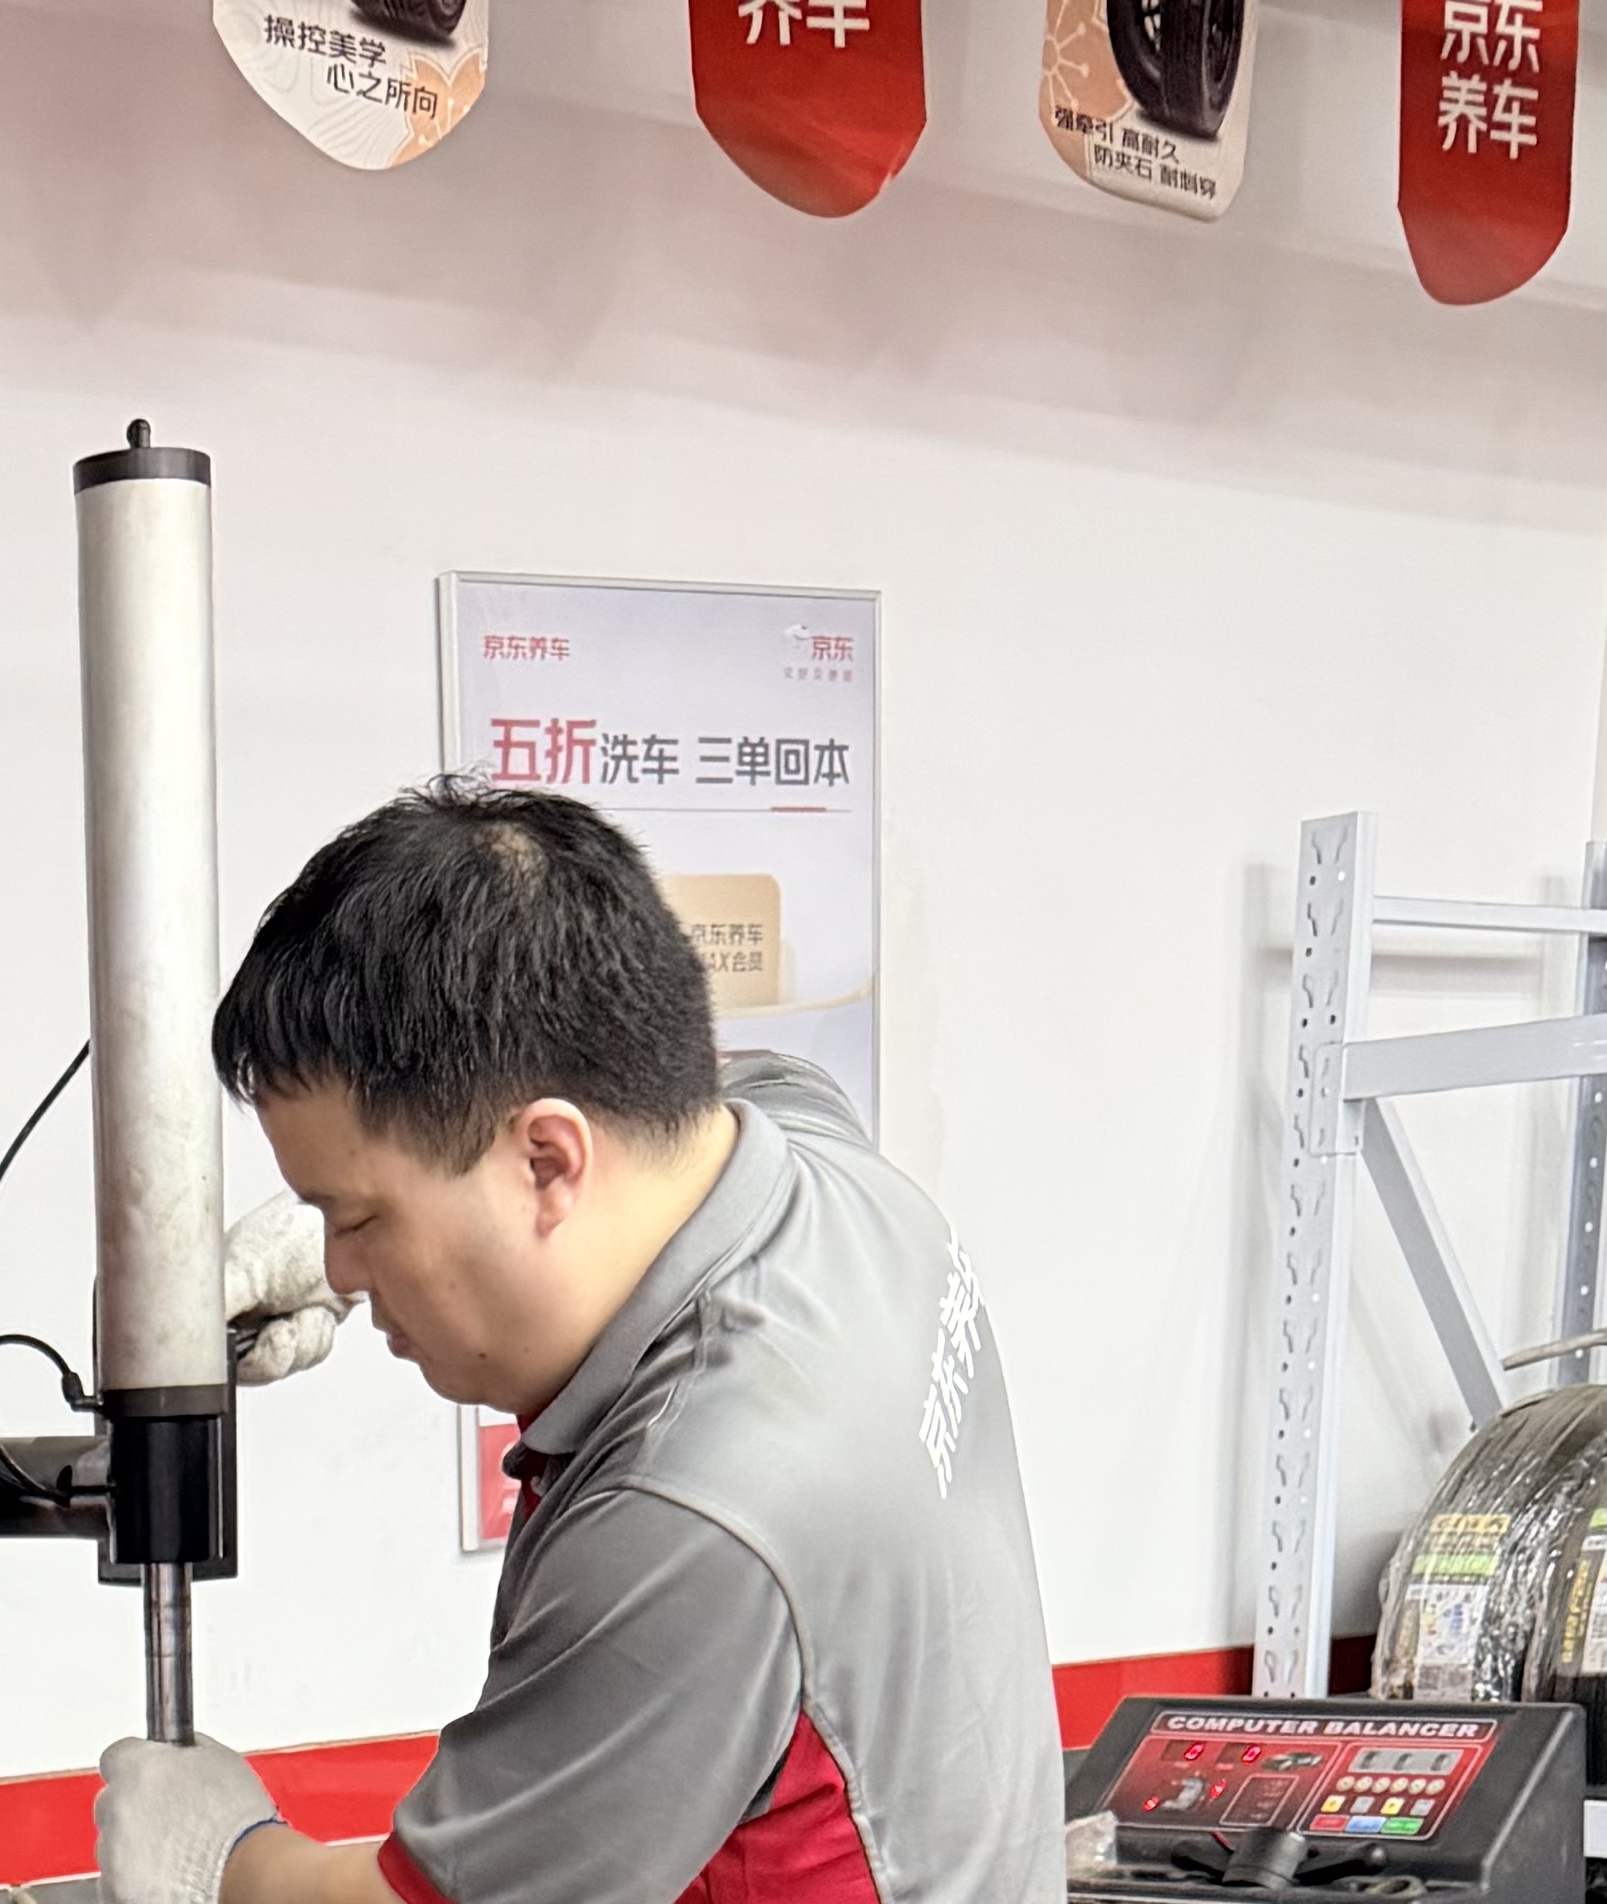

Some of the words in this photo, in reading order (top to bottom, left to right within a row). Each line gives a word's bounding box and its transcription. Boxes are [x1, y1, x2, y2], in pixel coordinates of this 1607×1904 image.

[263, 13, 386, 69] 操控美学
[1440, 0, 1543, 73] 京东
[326, 62, 438, 120] 心之所向
[1437, 70, 1539, 160] 养车
[482, 635, 571, 662] 京东养车
[810, 635, 854, 662] 京东
[491, 718, 679, 786] 五折洗车
[696, 736, 850, 787] 三单回本
[1167, 1716, 1318, 1735] COMPUTER
[1323, 1720, 1480, 1738] BALANCER
